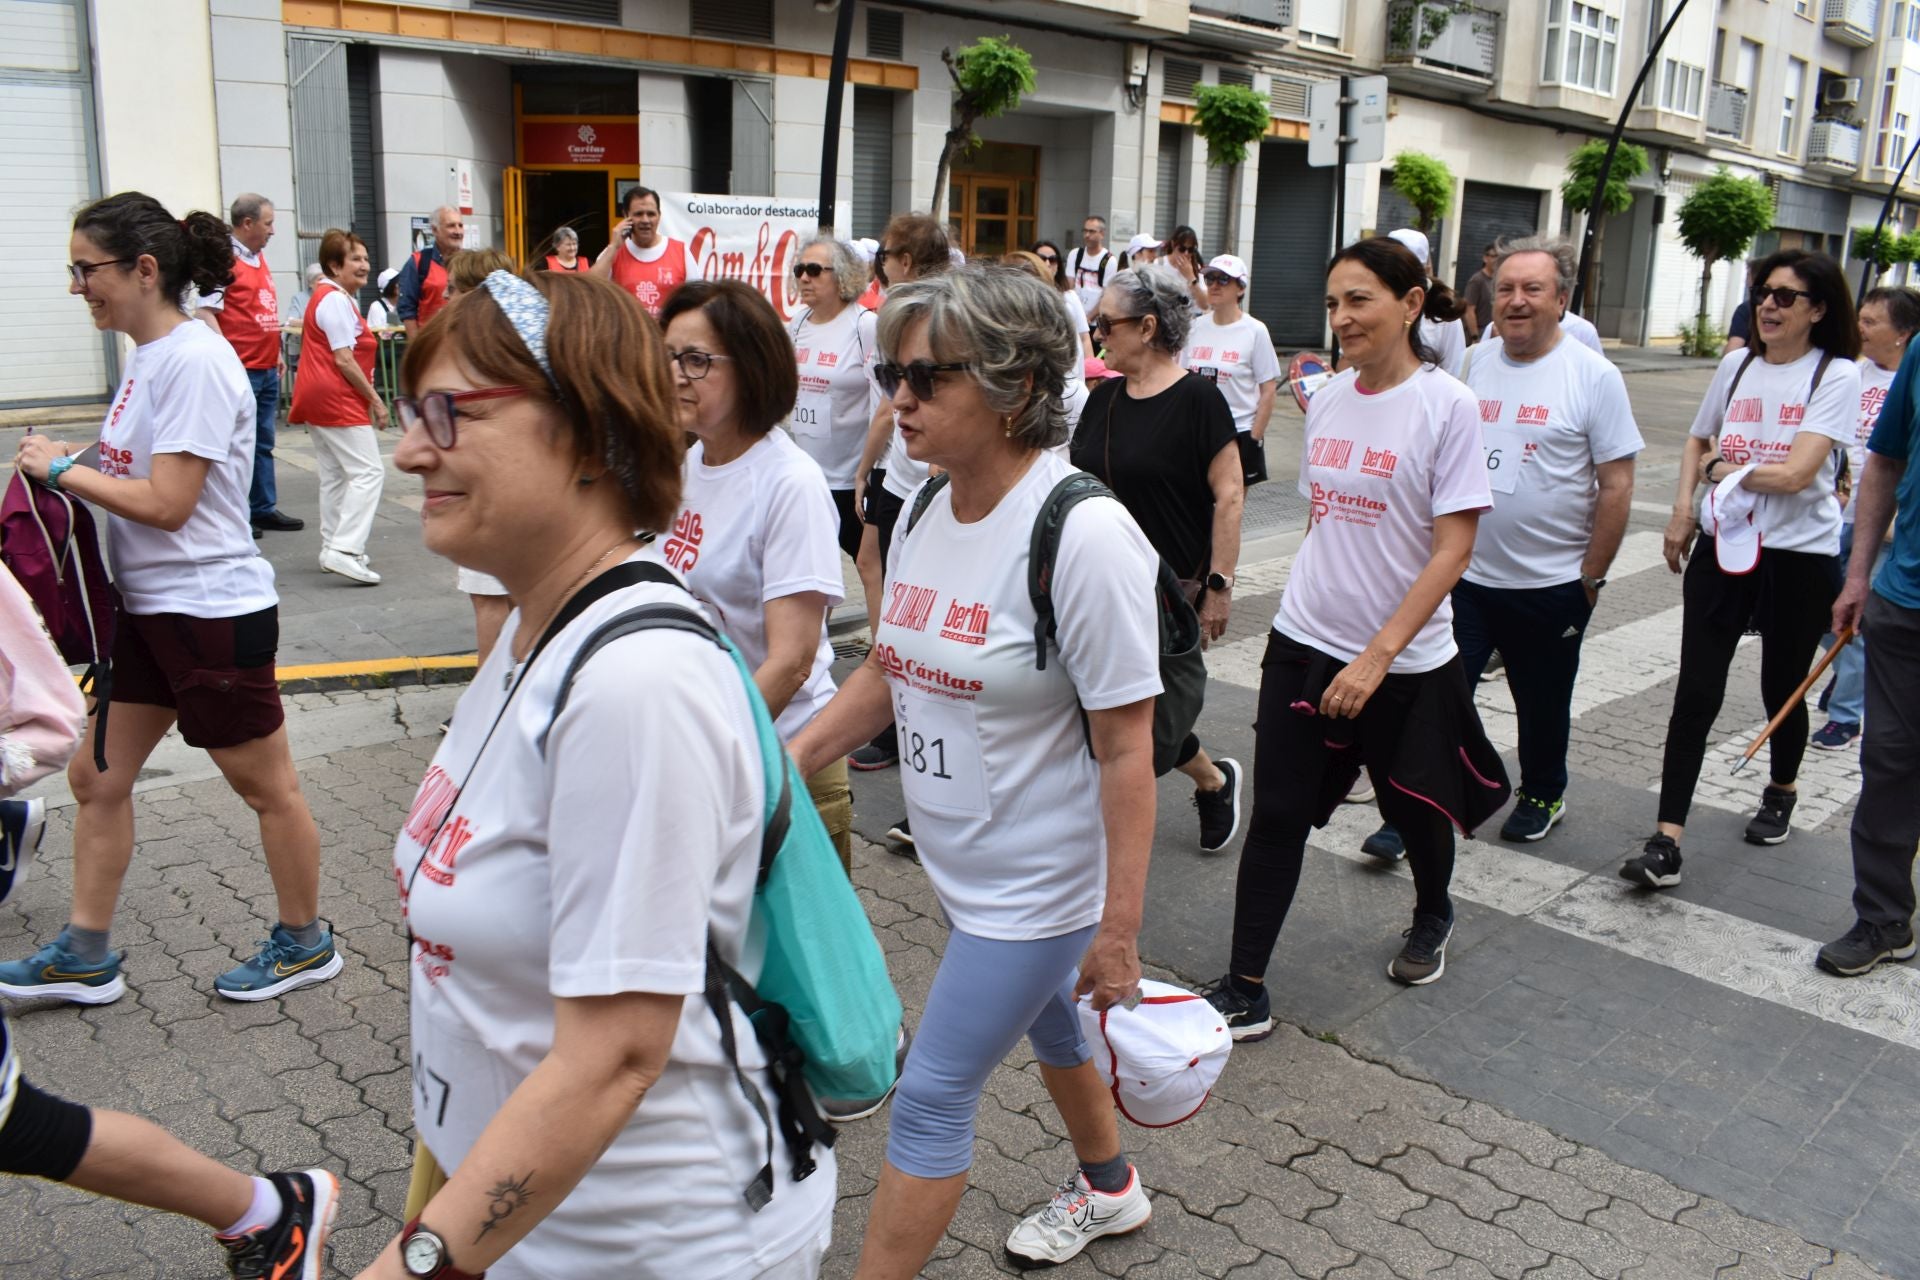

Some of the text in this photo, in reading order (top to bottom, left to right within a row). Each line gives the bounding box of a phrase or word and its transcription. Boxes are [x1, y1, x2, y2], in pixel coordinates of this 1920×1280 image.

[687, 201, 762, 217] Colaborador
[794, 406, 818, 425] 101
[1517, 403, 1549, 421] berlin
[1362, 446, 1397, 472] berlin
[1327, 490, 1387, 512] Cáritas
[943, 598, 990, 634] berlin
[940, 629, 986, 646] PACKAGING
[905, 658, 984, 692] Cáritas
[902, 725, 952, 780] 181
